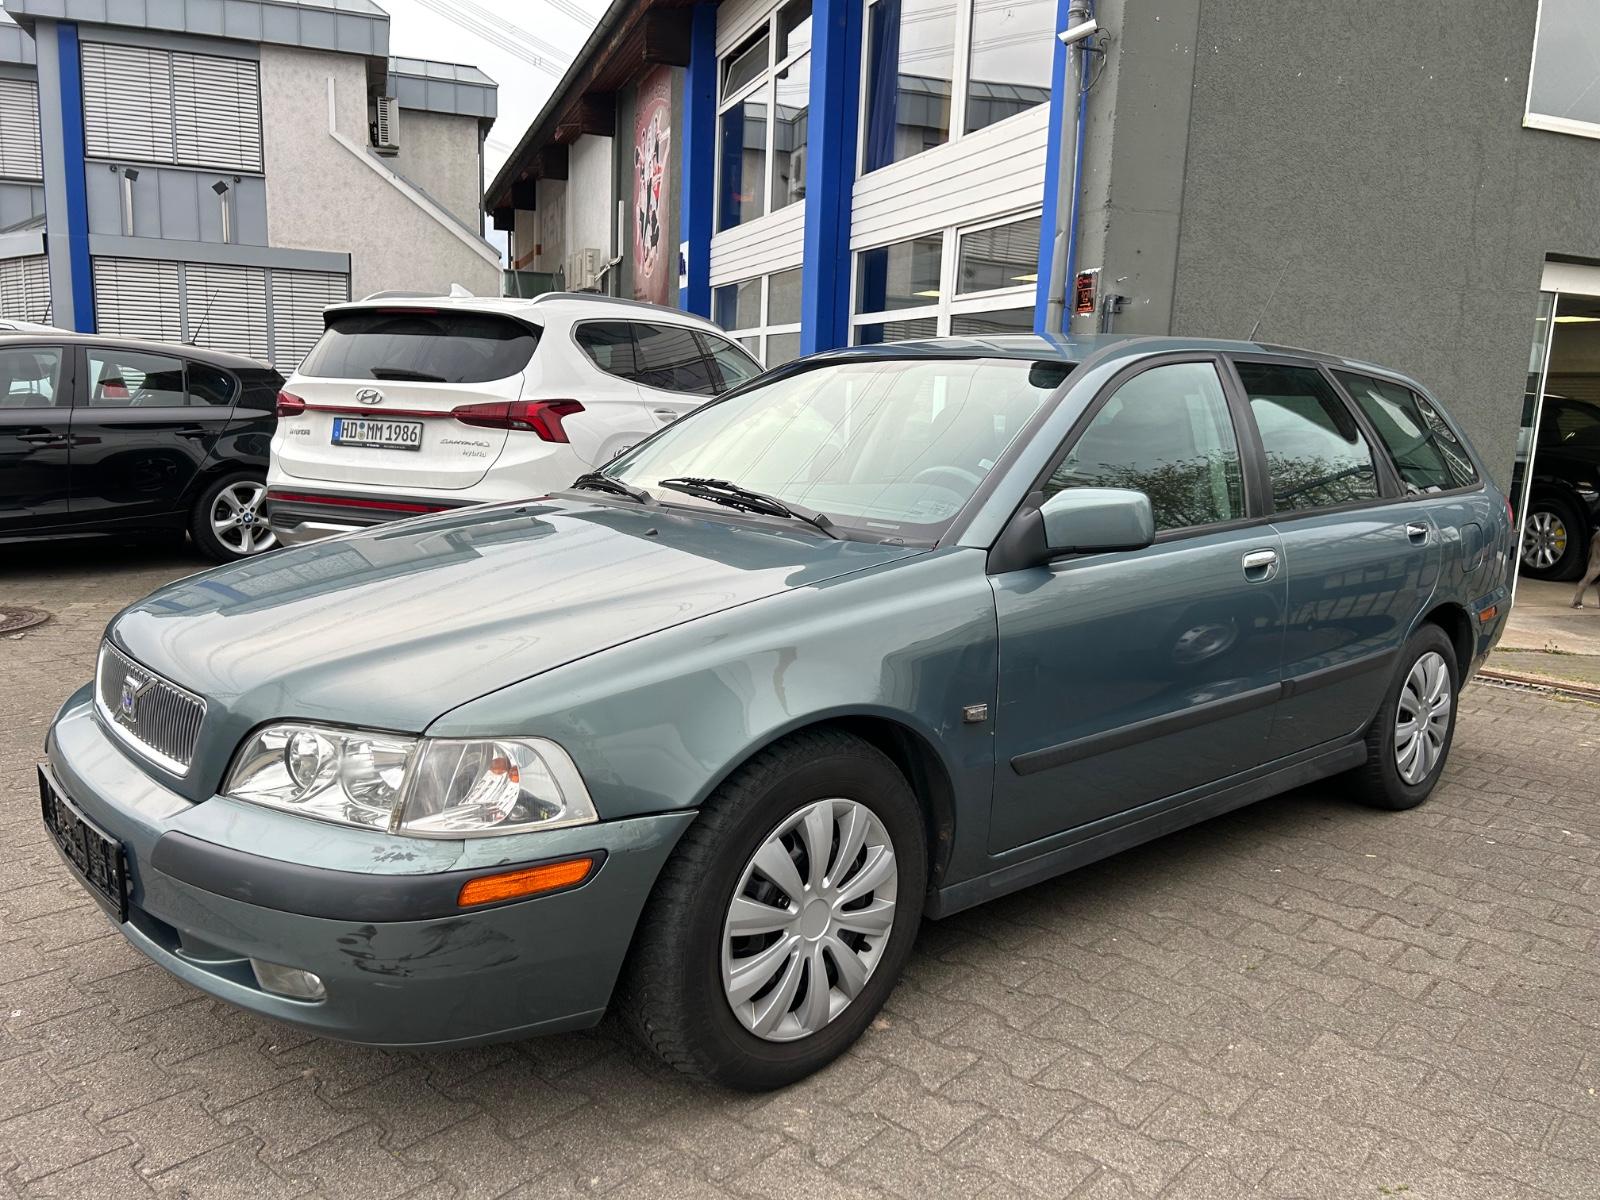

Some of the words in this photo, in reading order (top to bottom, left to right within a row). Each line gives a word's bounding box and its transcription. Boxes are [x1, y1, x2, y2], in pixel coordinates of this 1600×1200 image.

[341, 421, 358, 439] HD
[366, 422, 384, 441] MM
[385, 424, 418, 443] 1986
